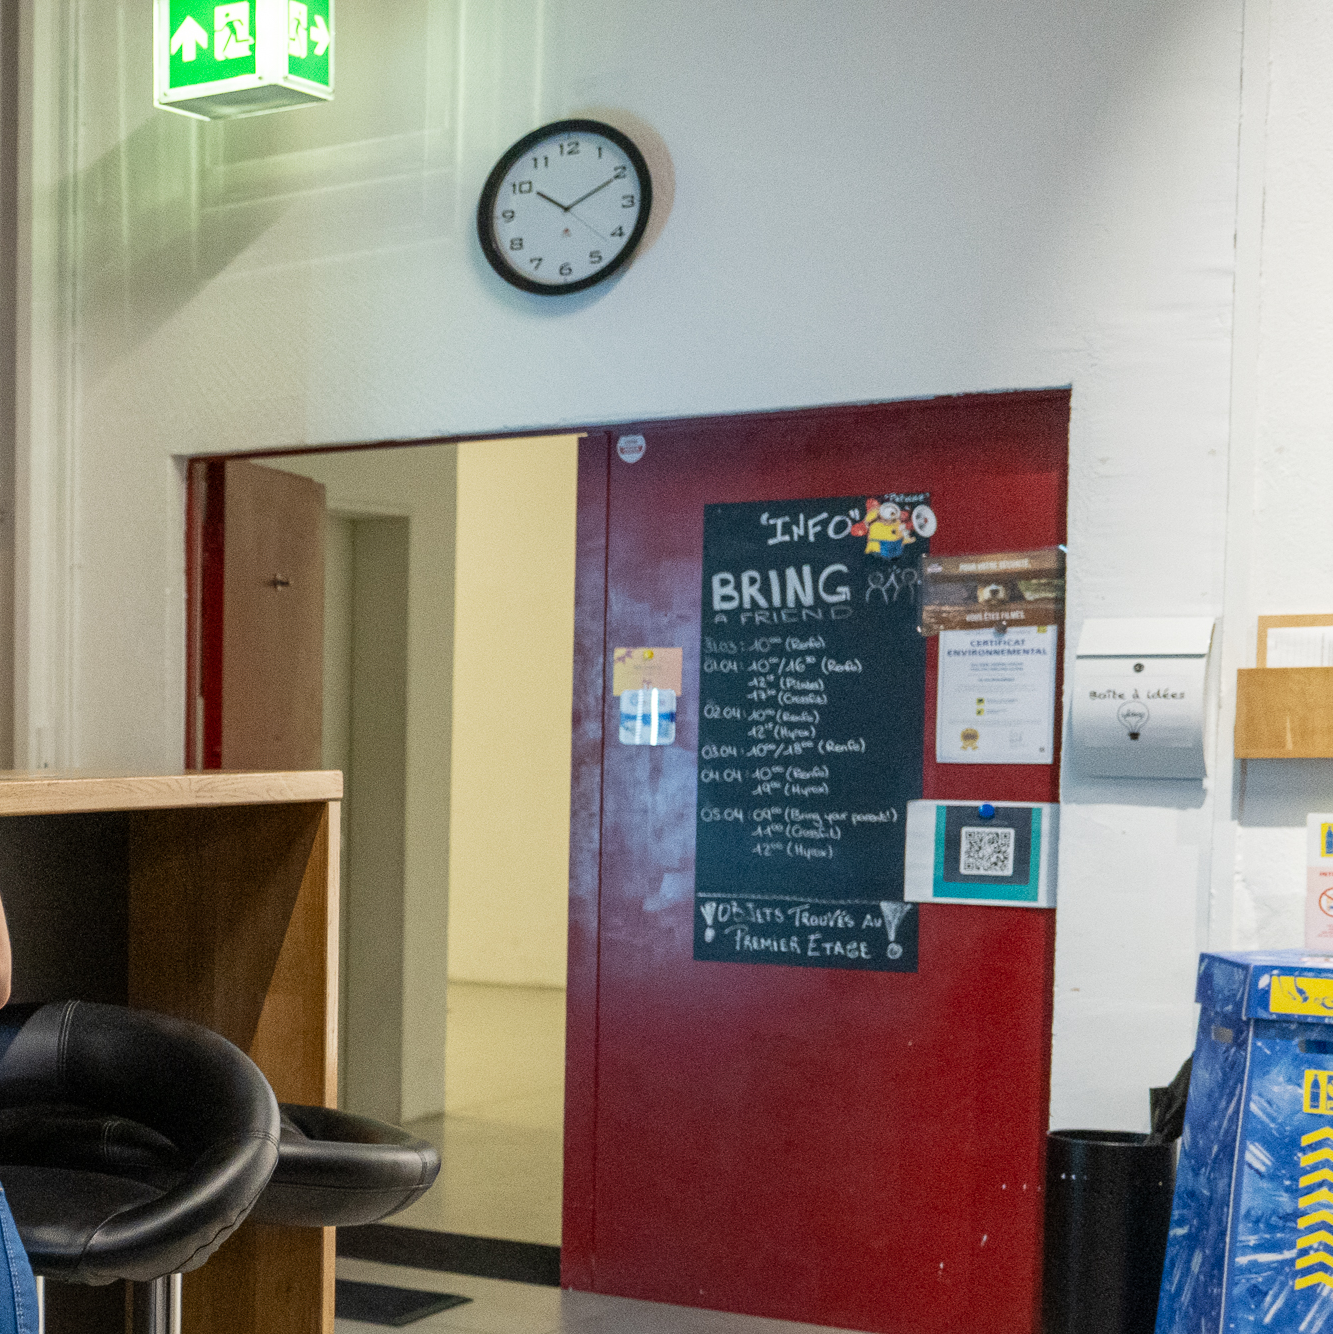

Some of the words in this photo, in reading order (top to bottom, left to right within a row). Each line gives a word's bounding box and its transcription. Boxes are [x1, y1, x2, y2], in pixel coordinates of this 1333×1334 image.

[559, 141, 580, 156] 12
[597, 146, 603, 159] 1
[533, 156, 549, 169] 11
[613, 165, 627, 180] 2
[512, 180, 533, 195] 10
[622, 194, 635, 209] 3
[502, 210, 515, 223] 9
[610, 226, 625, 238] 4
[510, 237, 524, 251] 8
[529, 257, 543, 271] 7
[589, 250, 603, 264] 5
[559, 262, 572, 276] 6
[712, 563, 851, 611] BRING
[714, 612, 728, 624] A
[740, 605, 853, 626] FRIEND
[970, 639, 1025, 647] CERTIFICAT
[947, 648, 1047, 657] ENVIRONNEMENTAL
